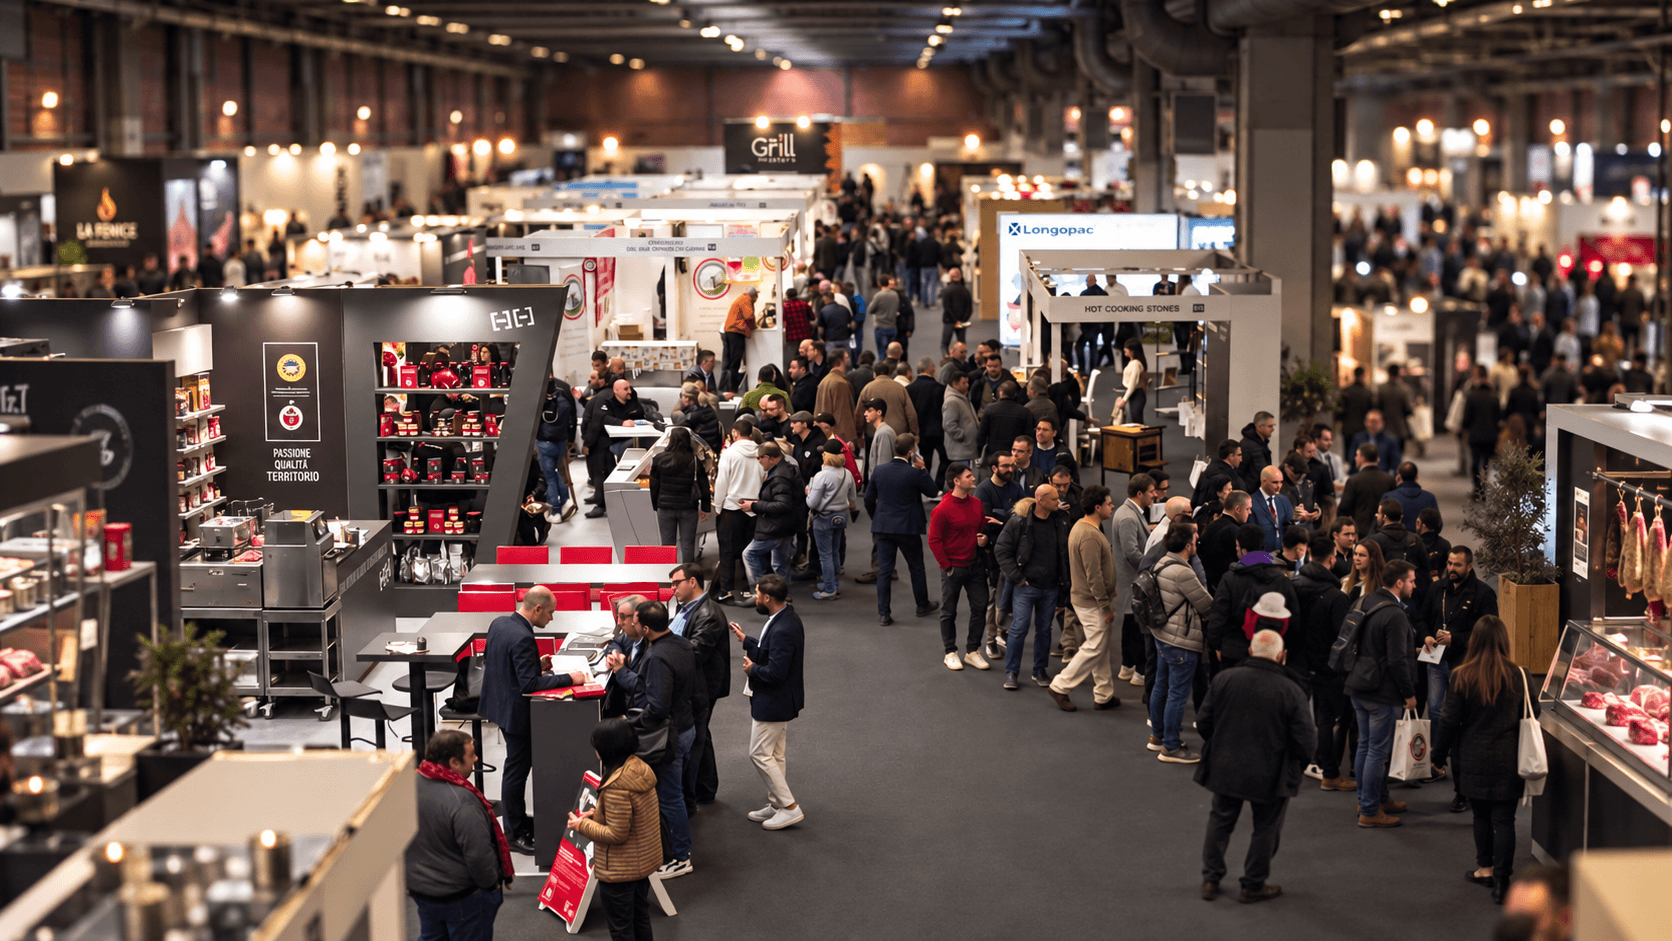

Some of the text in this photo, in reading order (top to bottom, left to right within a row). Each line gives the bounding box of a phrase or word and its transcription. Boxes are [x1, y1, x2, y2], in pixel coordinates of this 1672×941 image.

[751, 133, 796, 157] Grill
[1023, 225, 1094, 236] Longopac
[1084, 305, 1102, 313] HOT
[1105, 305, 1144, 313] COOKING
[273, 448, 311, 458] PASSIONE
[266, 471, 320, 482] TERRITORIO
